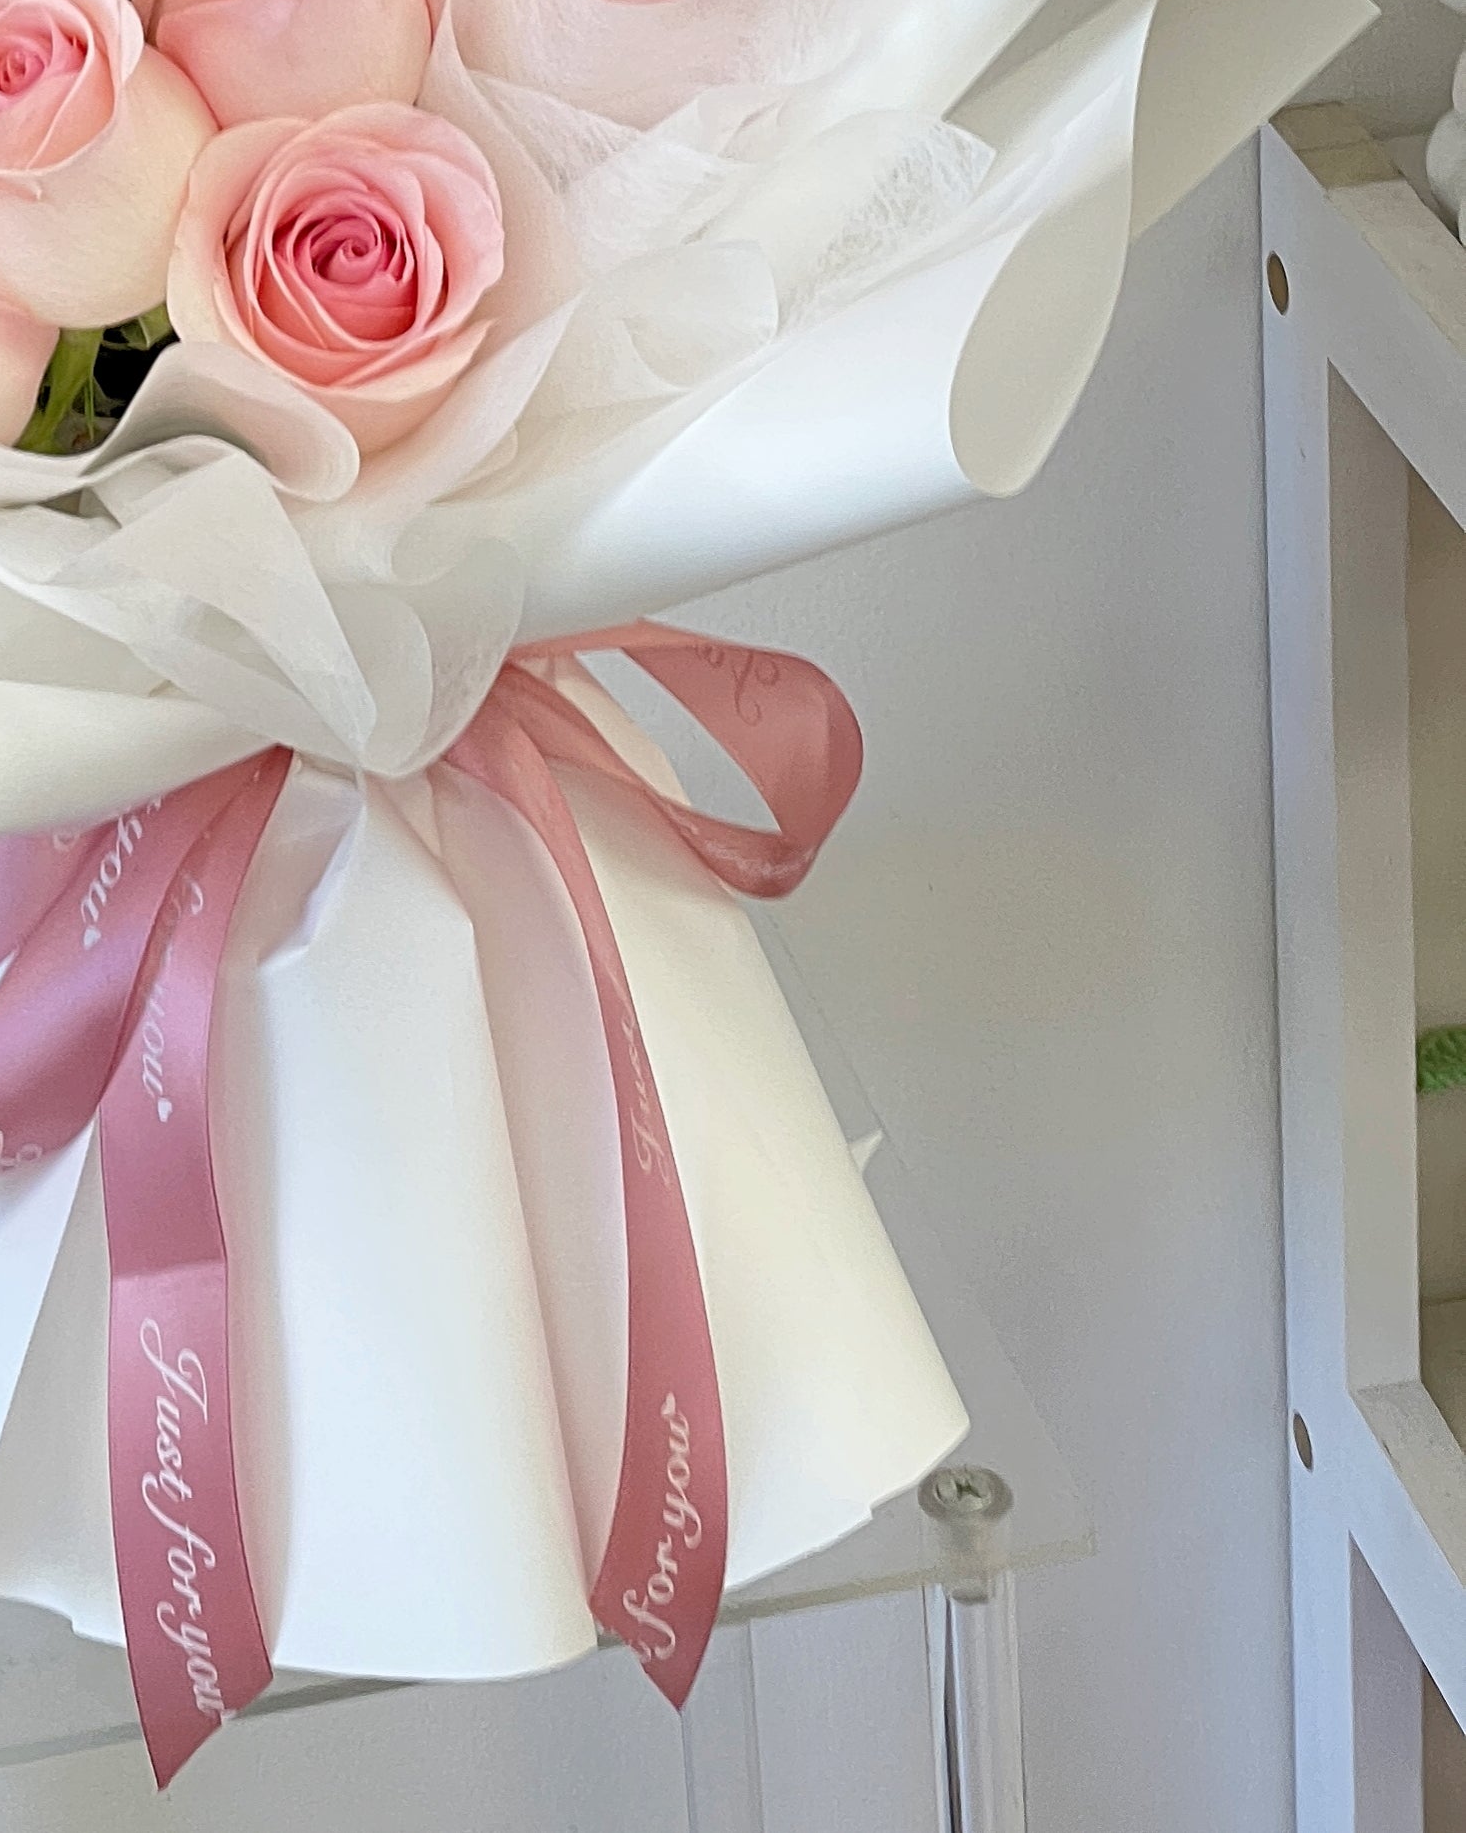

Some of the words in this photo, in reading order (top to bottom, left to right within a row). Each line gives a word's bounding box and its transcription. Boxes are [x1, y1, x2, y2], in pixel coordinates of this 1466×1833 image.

[138, 1316, 208, 1503] Just
[141, 1471, 216, 1625] for
[622, 1533, 677, 1661] for
[662, 1410, 703, 1550] you
[156, 1599, 227, 1723] you
